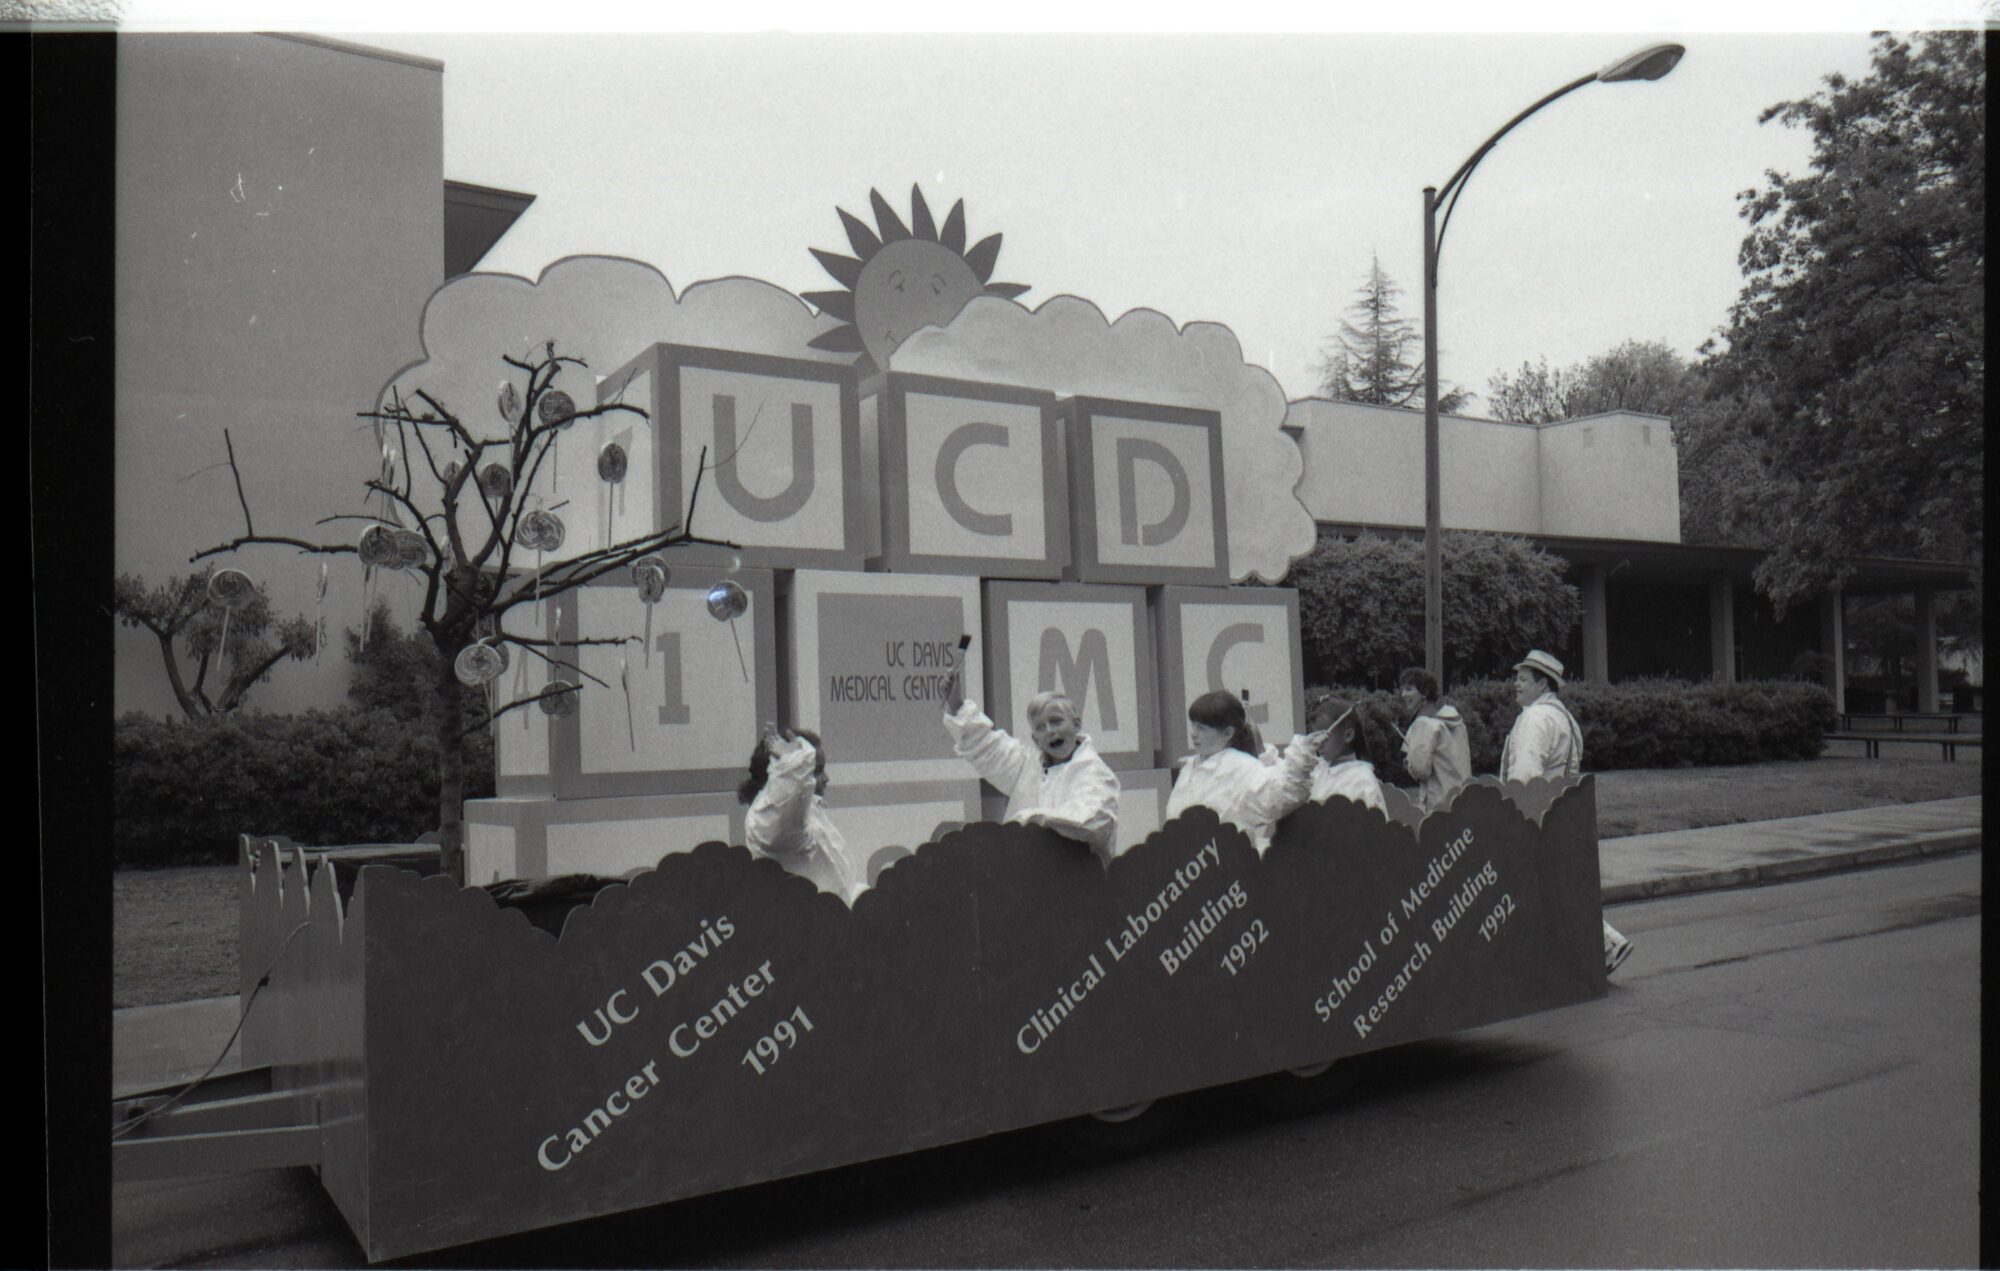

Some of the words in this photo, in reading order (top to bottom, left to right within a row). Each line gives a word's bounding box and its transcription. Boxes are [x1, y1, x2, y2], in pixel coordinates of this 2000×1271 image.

[830, 675, 897, 702] MEDICAL
[903, 675, 960, 701] CENTE
[886, 641, 905, 668] UC
[912, 641, 955, 668] DAVIS
[1015, 953, 1107, 1056] Clinical
[1104, 836, 1222, 962] Laboratory
[1158, 880, 1249, 977] Building
[1219, 918, 1270, 977] 1992
[1313, 940, 1378, 1023] School
[1379, 911, 1399, 946] of
[1400, 825, 1476, 920] Medicine
[1353, 940, 1432, 1040] Research
[1430, 859, 1499, 943] Building
[1477, 893, 1516, 943] 1992
[575, 988, 640, 1047] UC
[641, 914, 736, 997] Davis
[536, 1059, 661, 1172] Cancer
[668, 958, 776, 1058] Center
[741, 1005, 816, 1076] 1991
